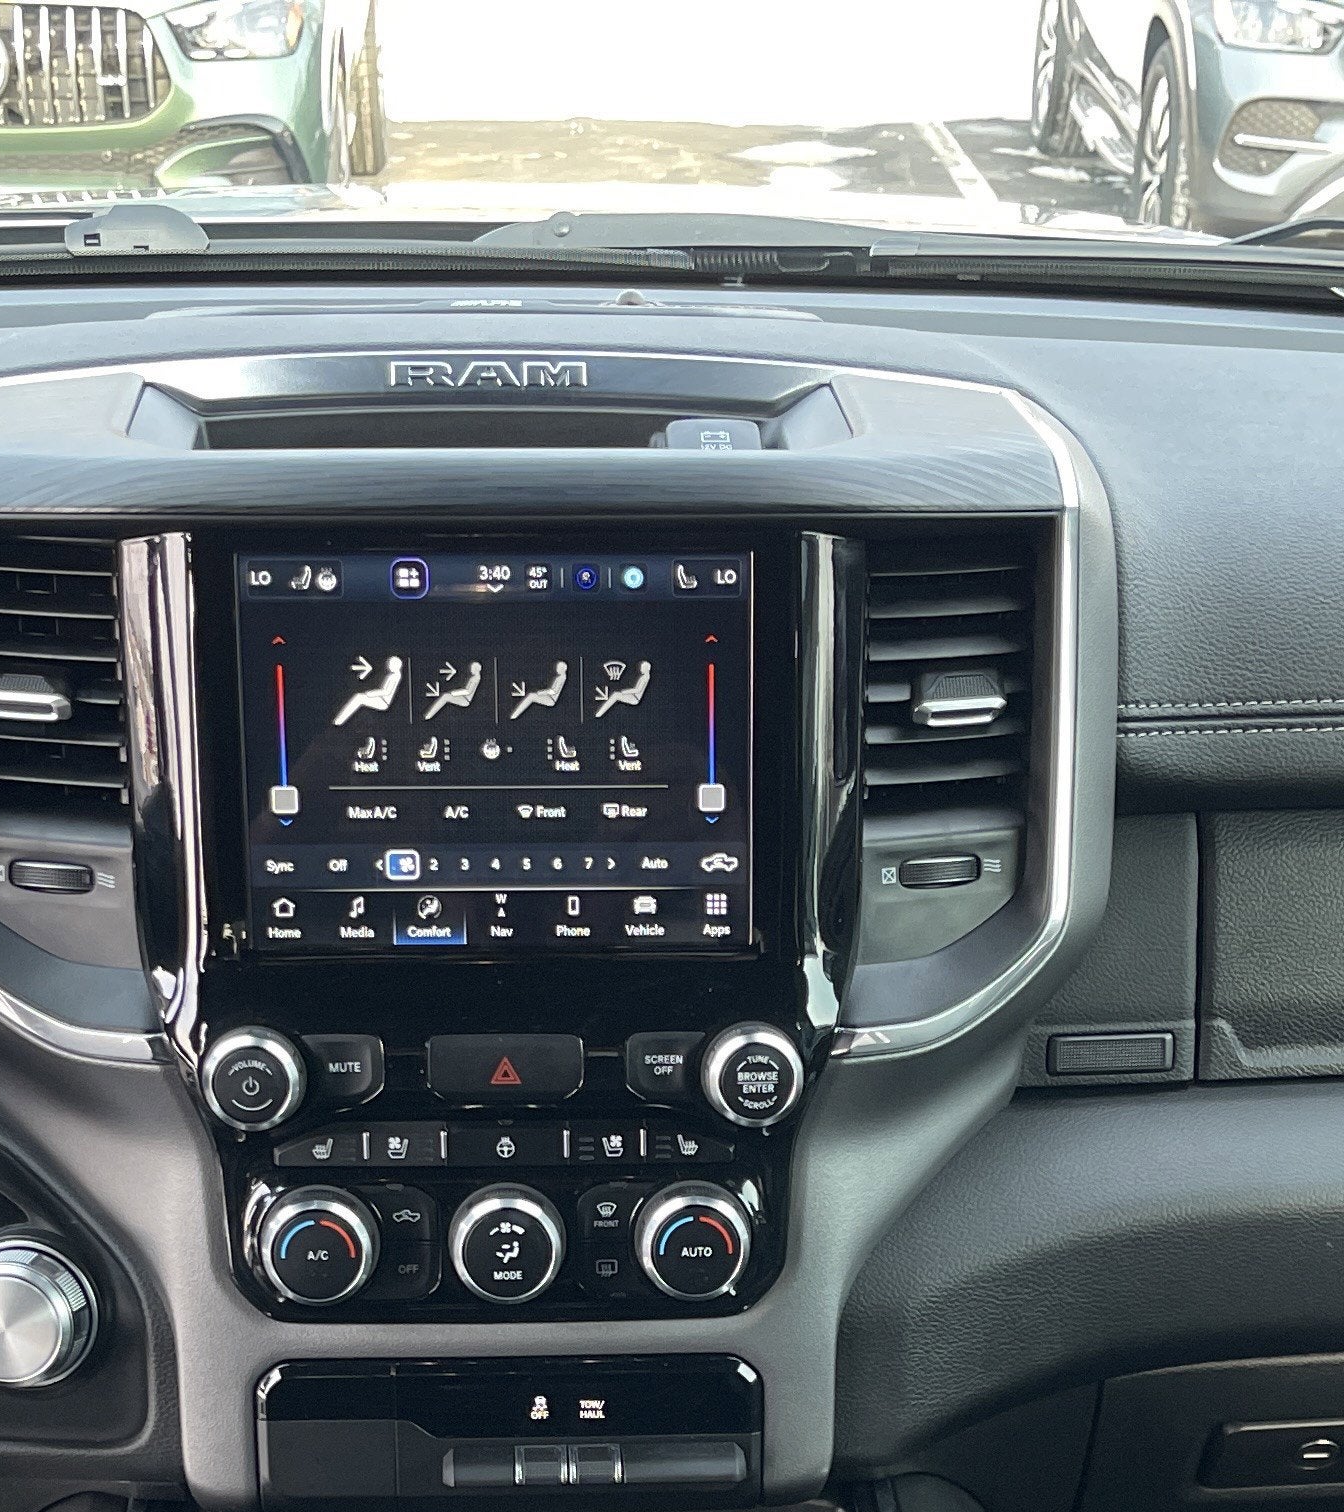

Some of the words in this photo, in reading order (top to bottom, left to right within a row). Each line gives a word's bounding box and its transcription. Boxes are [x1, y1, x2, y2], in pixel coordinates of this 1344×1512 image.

[389, 360, 588, 388] RAM
[249, 570, 272, 586] LO
[479, 565, 511, 582] 3:40
[716, 570, 737, 585] LO
[529, 579, 549, 590] OUT
[354, 760, 379, 773] Heat
[417, 760, 441, 773] Vent
[556, 759, 580, 772] Heat
[618, 759, 642, 772] Vent
[444, 805, 469, 819] A/C
[536, 805, 566, 818] Front
[621, 805, 647, 818] Rear
[266, 859, 295, 873] Sync
[328, 859, 348, 872] Off
[429, 858, 439, 871] 2
[460, 857, 470, 871] 3
[490, 857, 501, 871] 4
[522, 857, 531, 871] 5
[553, 857, 562, 871] 6
[584, 857, 594, 870] 7
[641, 856, 669, 870] Auto
[267, 926, 302, 939] Home
[339, 926, 375, 939] Media
[407, 925, 452, 939] Comfort
[490, 925, 513, 938] Nav
[556, 925, 591, 938] Phone
[625, 924, 665, 937] Vehicle
[703, 924, 731, 938] Apps
[233, 1059, 267, 1072] VOLUME
[644, 1055, 683, 1065] SCREEN
[747, 1055, 770, 1065] TUNE
[328, 1062, 362, 1073] MUTE
[653, 1065, 673, 1076] OFF
[737, 1071, 779, 1082] BROWSE
[742, 1083, 775, 1094] ENTER
[742, 1099, 775, 1110] SCROLL
[593, 1219, 620, 1228] FRONT
[306, 1250, 330, 1261] A/C
[681, 1246, 713, 1258] AUTO
[398, 1264, 419, 1275] OFF
[493, 1270, 523, 1281] MODE
[530, 1410, 549, 1420] OFF
[579, 1409, 605, 1420] HAUL
